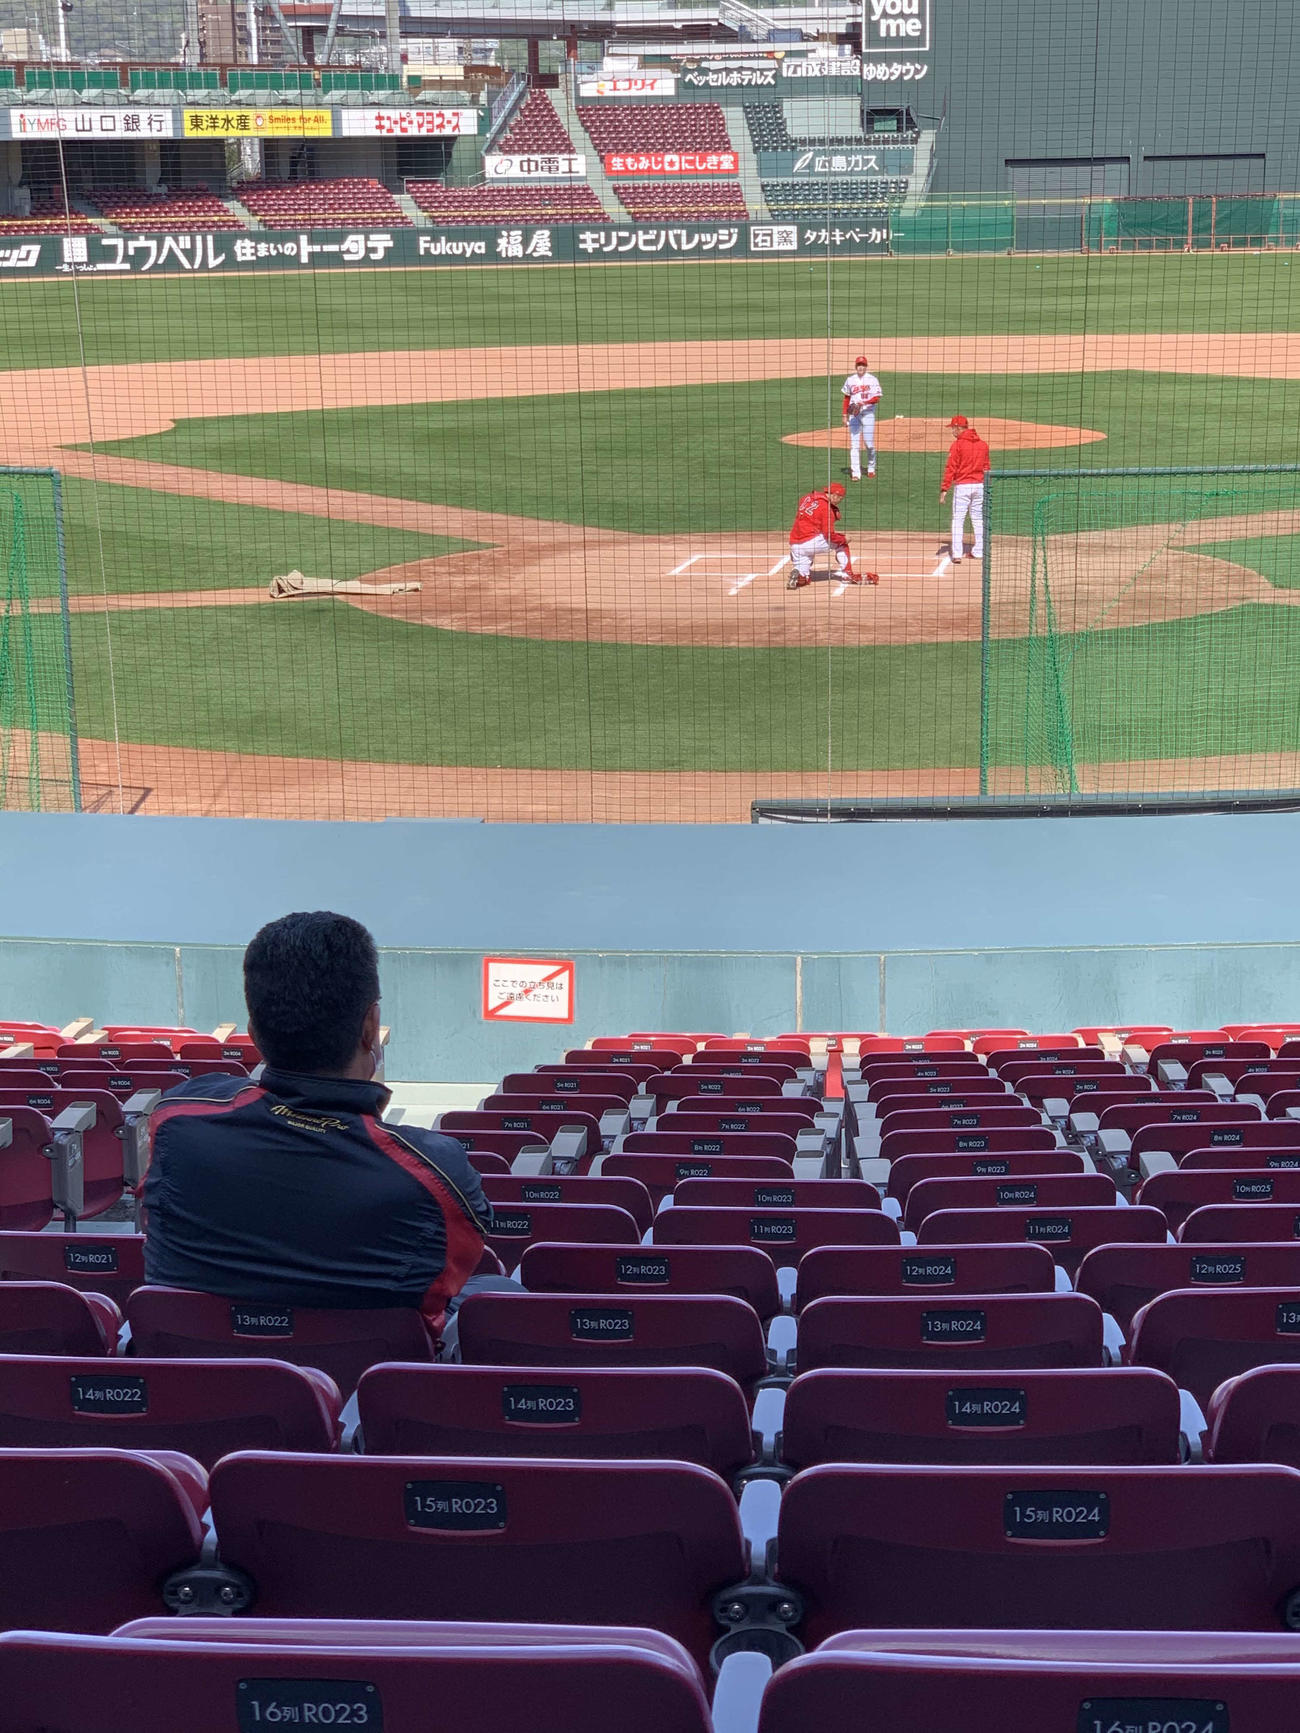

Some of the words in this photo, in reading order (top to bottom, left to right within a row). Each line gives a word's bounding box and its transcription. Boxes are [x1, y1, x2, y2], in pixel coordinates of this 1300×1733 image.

[870, 0, 919, 21] you
[880, 18, 922, 37] me
[863, 62, 928, 80] ゆめタウン
[685, 69, 776, 87] ベッセルホテルズ
[27, 117, 67, 132] YMFG
[75, 113, 165, 132] 山口銀行
[189, 114, 250, 131] 東洋水産
[268, 114, 297, 125] Smiles
[300, 114, 312, 125] for
[520, 157, 580, 176] 中電工
[611, 156, 662, 171] 生もみじ
[681, 155, 734, 170] にしき堂
[814, 154, 880, 172] 広島ガス
[419, 236, 486, 257] Fukuya
[496, 229, 553, 258] 福屋
[579, 228, 739, 253] キリンビバレッジ
[493, 979, 564, 991] ここでの立ち見は
[704, 1144, 720, 1152] R022
[968, 1140, 985, 1148] R023
[690, 1168, 708, 1177] R022
[987, 1165, 1006, 1174] R023
[539, 1190, 560, 1199] R022
[1014, 1190, 1035, 1199] R024
[1250, 1184, 1271, 1193] R025
[772, 1193, 793, 1203] R023
[506, 1219, 529, 1229] R022
[770, 1224, 793, 1235] R023
[1046, 1224, 1069, 1234] R024
[88, 1253, 113, 1264] R021
[640, 1264, 666, 1275] R023
[925, 1265, 952, 1276] R024
[1215, 1263, 1241, 1274] R025
[259, 1314, 289, 1328] R022
[599, 1318, 630, 1331] R023
[951, 1319, 981, 1332] R024
[105, 1387, 142, 1402] R022
[538, 1397, 575, 1412] R023
[983, 1400, 1020, 1415] R024
[451, 1496, 498, 1514] R023
[1052, 1506, 1100, 1524] R024
[303, 1701, 369, 1725] R023
